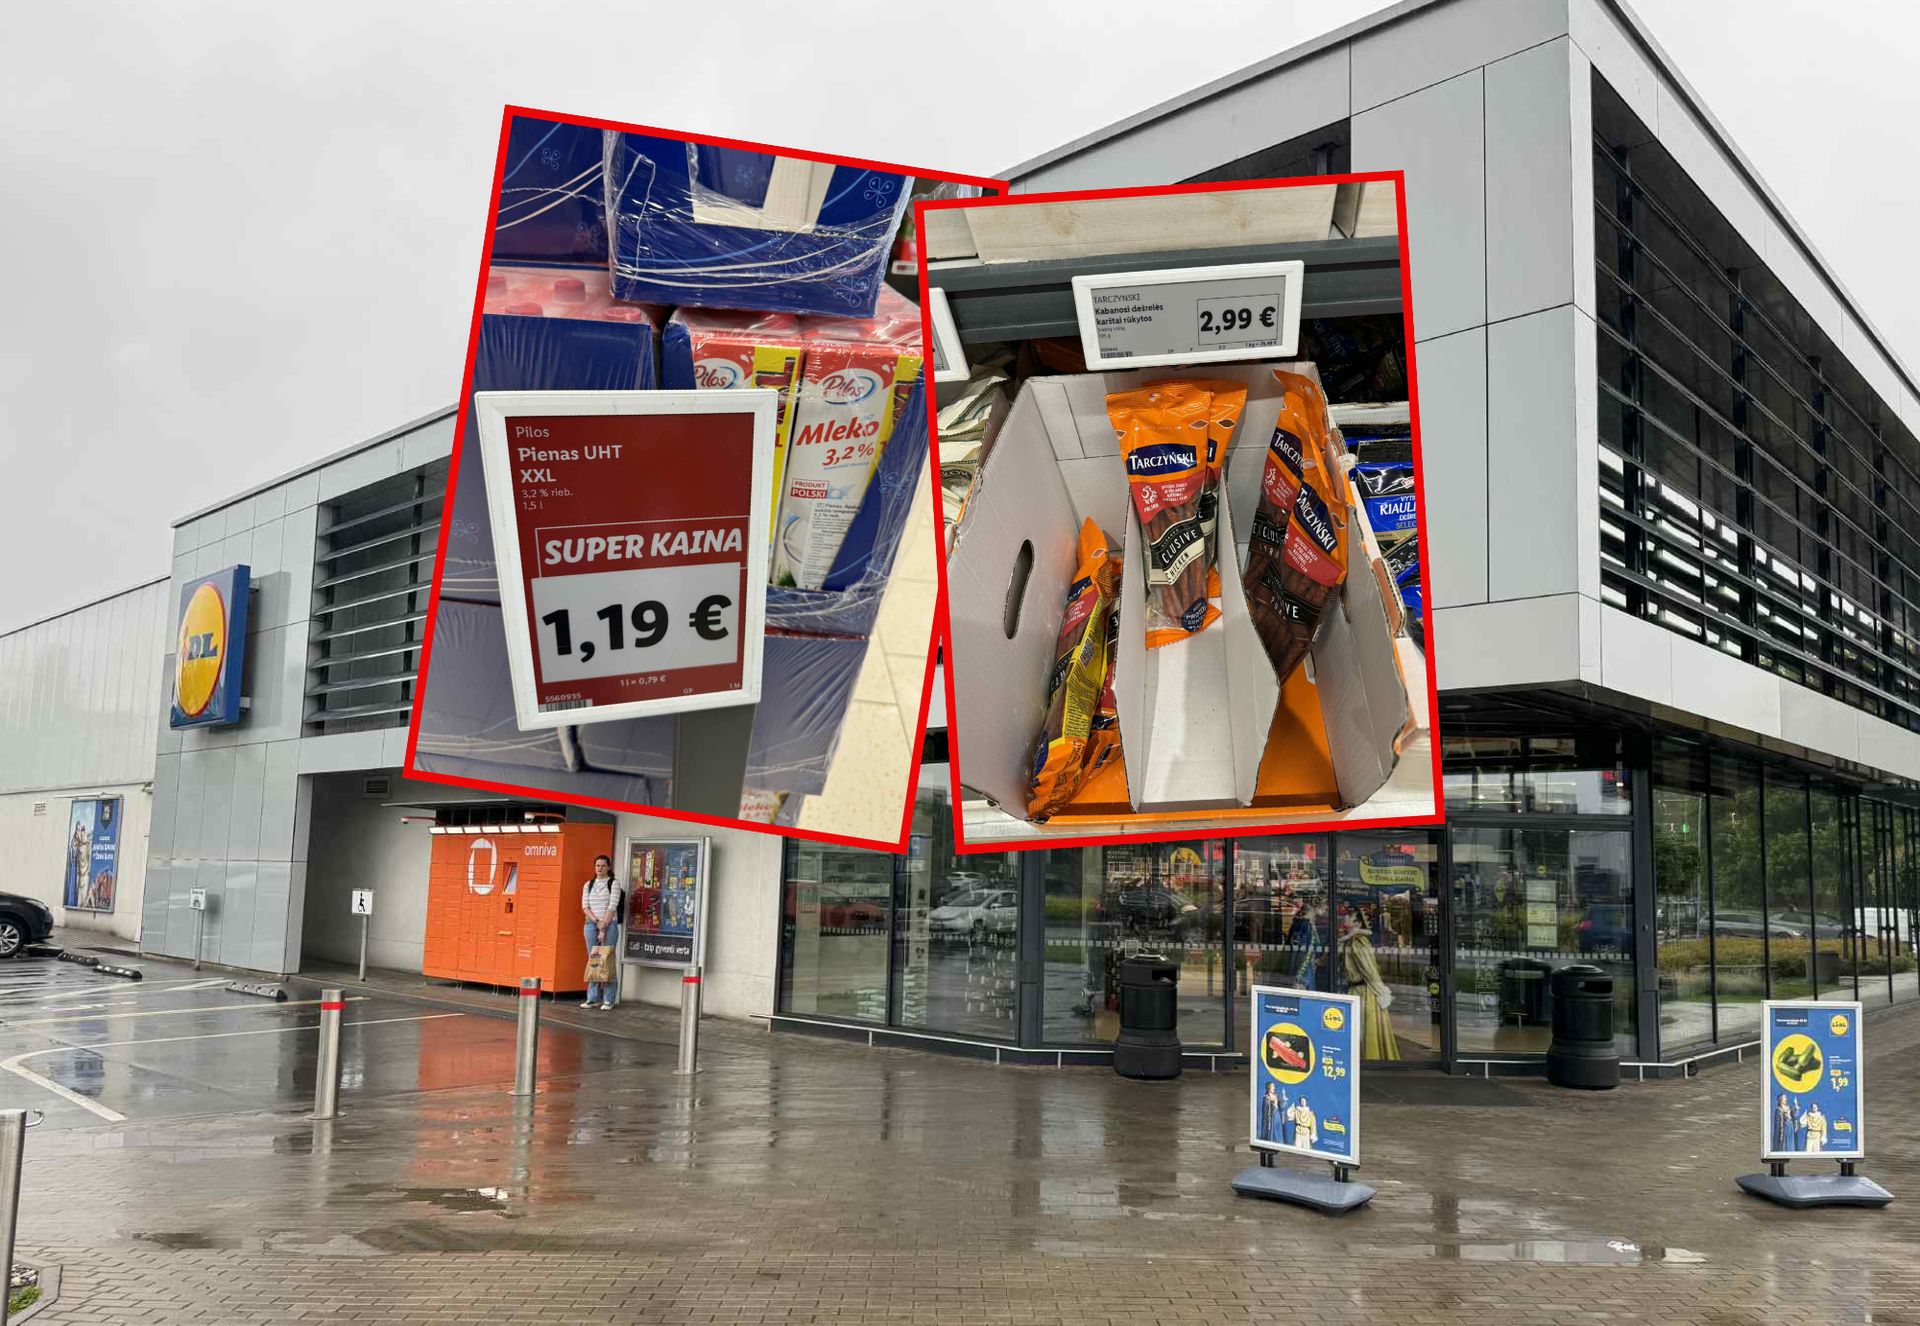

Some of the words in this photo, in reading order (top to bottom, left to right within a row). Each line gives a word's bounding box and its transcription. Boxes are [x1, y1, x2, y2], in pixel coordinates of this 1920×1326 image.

[1095, 304, 1130, 315] Kabanosi
[1096, 316, 1123, 326] karštai
[1124, 315, 1153, 324] rūkytos
[1200, 307, 1252, 335] 2,99
[1259, 306, 1276, 328] €
[694, 365, 728, 388] Pilos
[822, 374, 865, 398] Pilos
[516, 426, 550, 438] Pilos
[796, 416, 880, 446] Mleko
[518, 446, 579, 462] Pienas
[584, 444, 622, 460] UHT
[822, 446, 854, 466] 3,2
[858, 442, 874, 458] %
[520, 468, 557, 484] XXL
[522, 489, 537, 499] 3,2
[540, 488, 548, 497] %
[551, 487, 574, 497] rieb.
[523, 501, 537, 511] 1,5
[544, 534, 645, 566] SUPER
[650, 528, 743, 556] KAINA
[1165, 552, 1190, 581] CHICKEN
[542, 600, 670, 664] 1,19
[689, 594, 733, 641] €
[638, 676, 658, 686] 0,79
[524, 843, 557, 857] omniva
